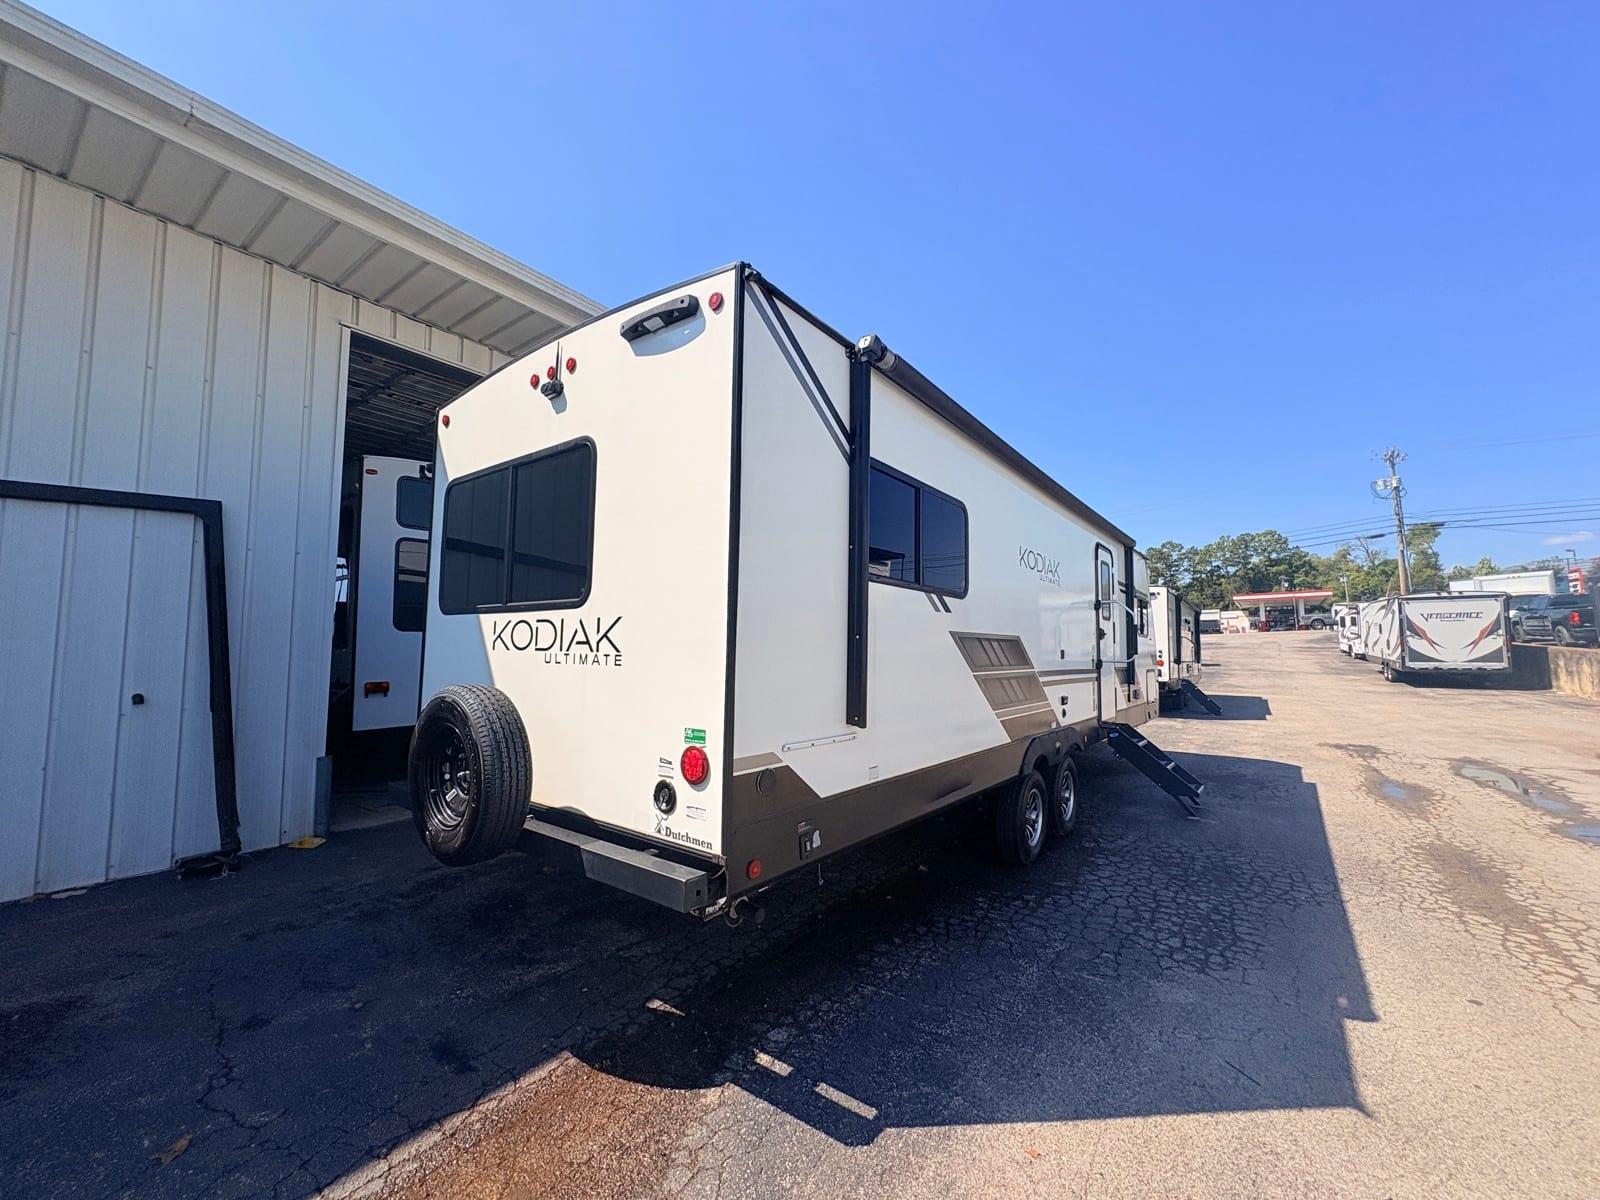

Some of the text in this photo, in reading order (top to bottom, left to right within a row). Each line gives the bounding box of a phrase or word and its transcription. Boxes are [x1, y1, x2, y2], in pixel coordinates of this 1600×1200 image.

[1019, 545, 1060, 579] KODIAK
[1419, 611, 1483, 622] VENGEANCE
[492, 616, 623, 653] KODIAK
[544, 652, 622, 666] ULTIMATE
[664, 825, 713, 850] Dutchmen
